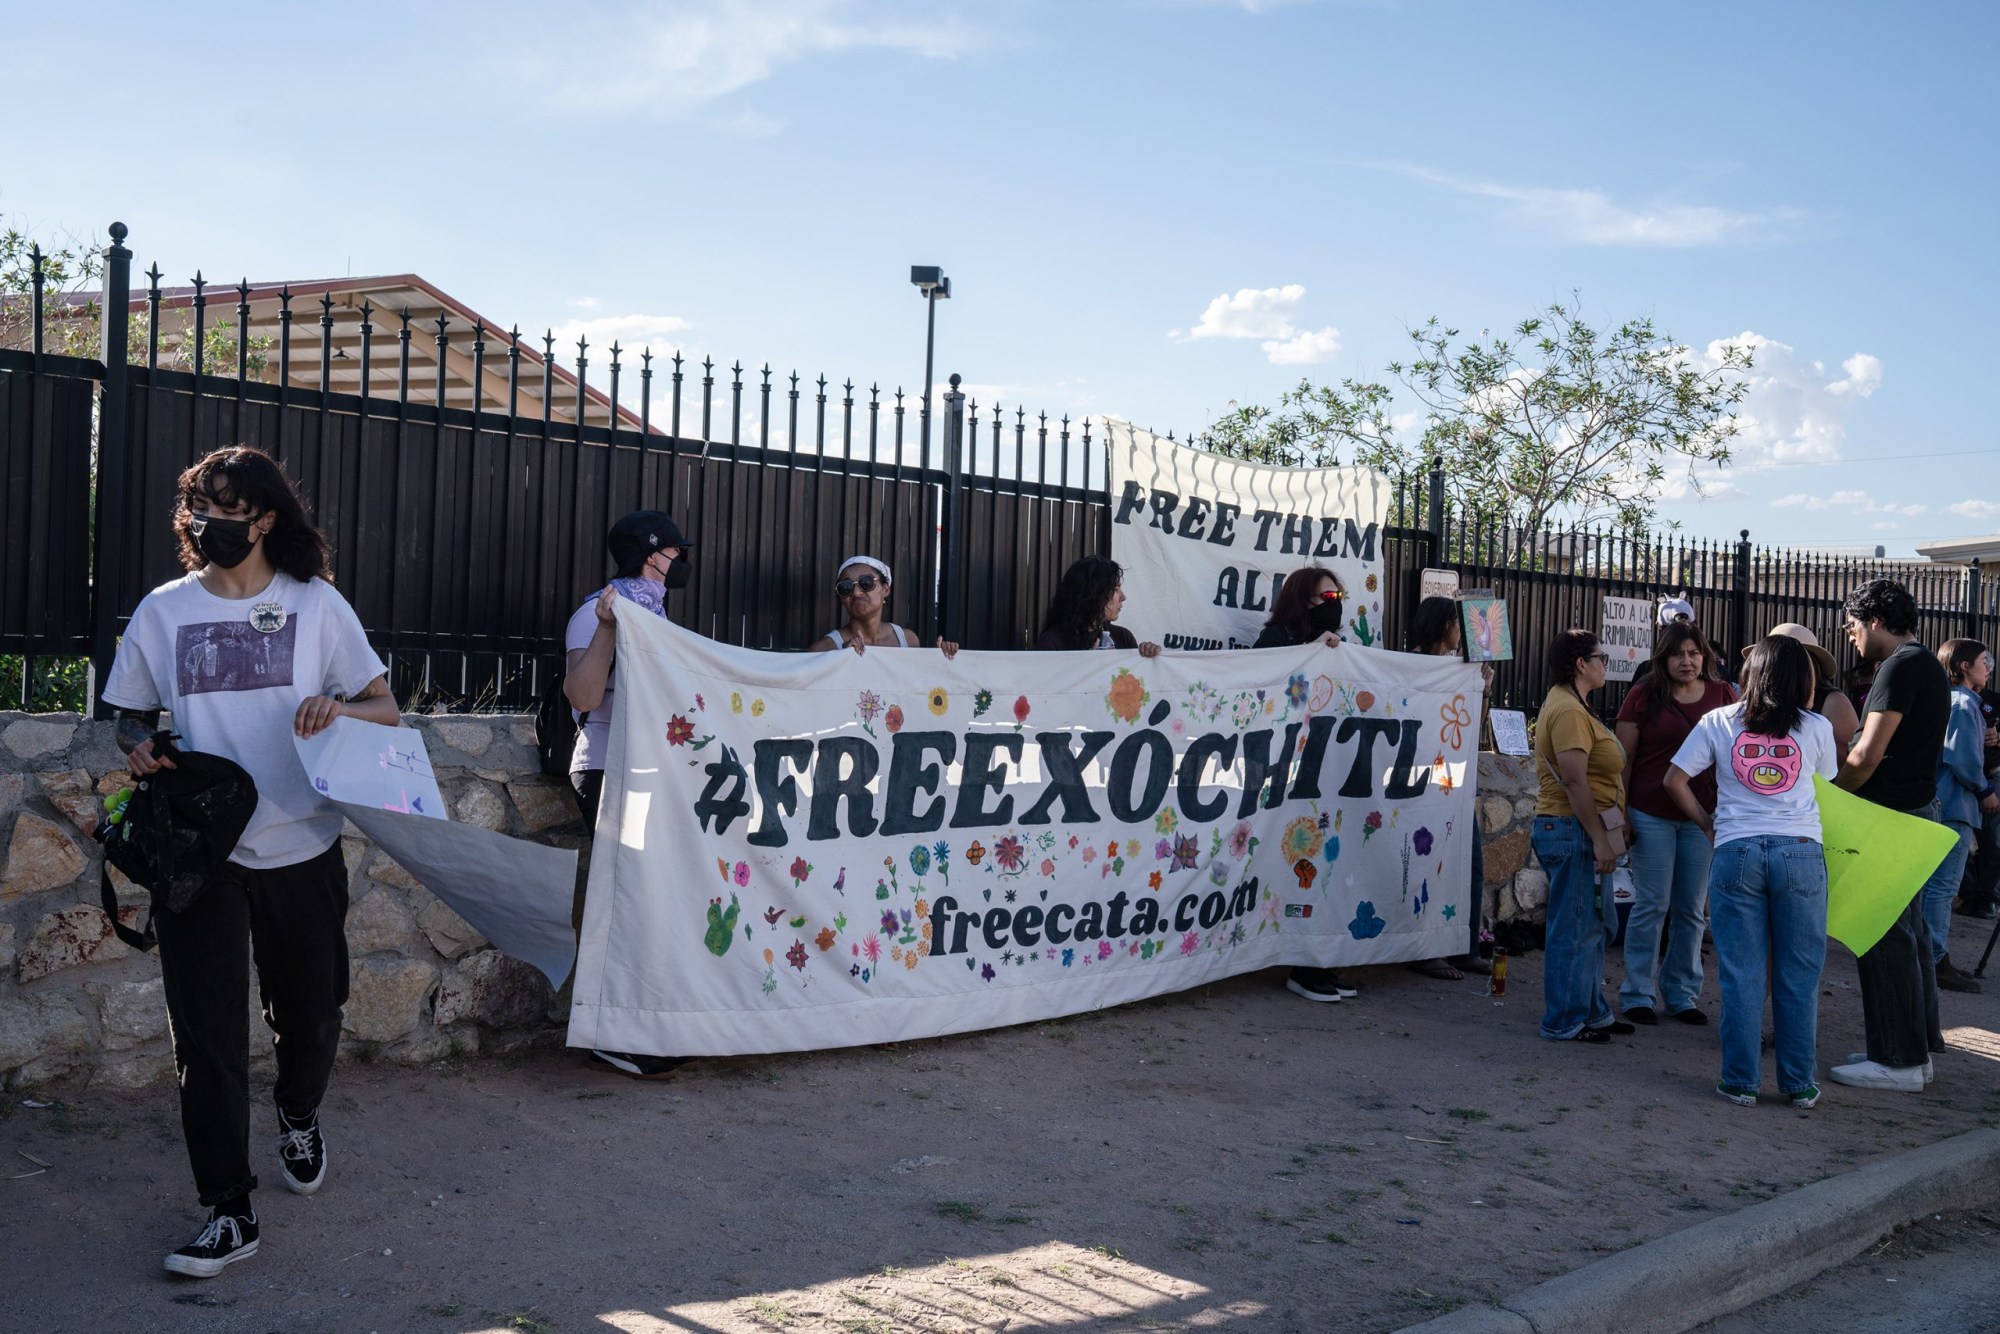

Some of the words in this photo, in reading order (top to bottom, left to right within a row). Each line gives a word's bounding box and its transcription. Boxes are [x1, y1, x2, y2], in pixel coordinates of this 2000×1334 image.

[1114, 480, 1241, 546] FREE
[1253, 509, 1379, 562] THEM
[1603, 601, 1625, 620] ALTO
[1629, 604, 1636, 622] A
[694, 700, 1431, 848] #FREEXÓCHITL
[928, 876, 1259, 956] freecata.com
